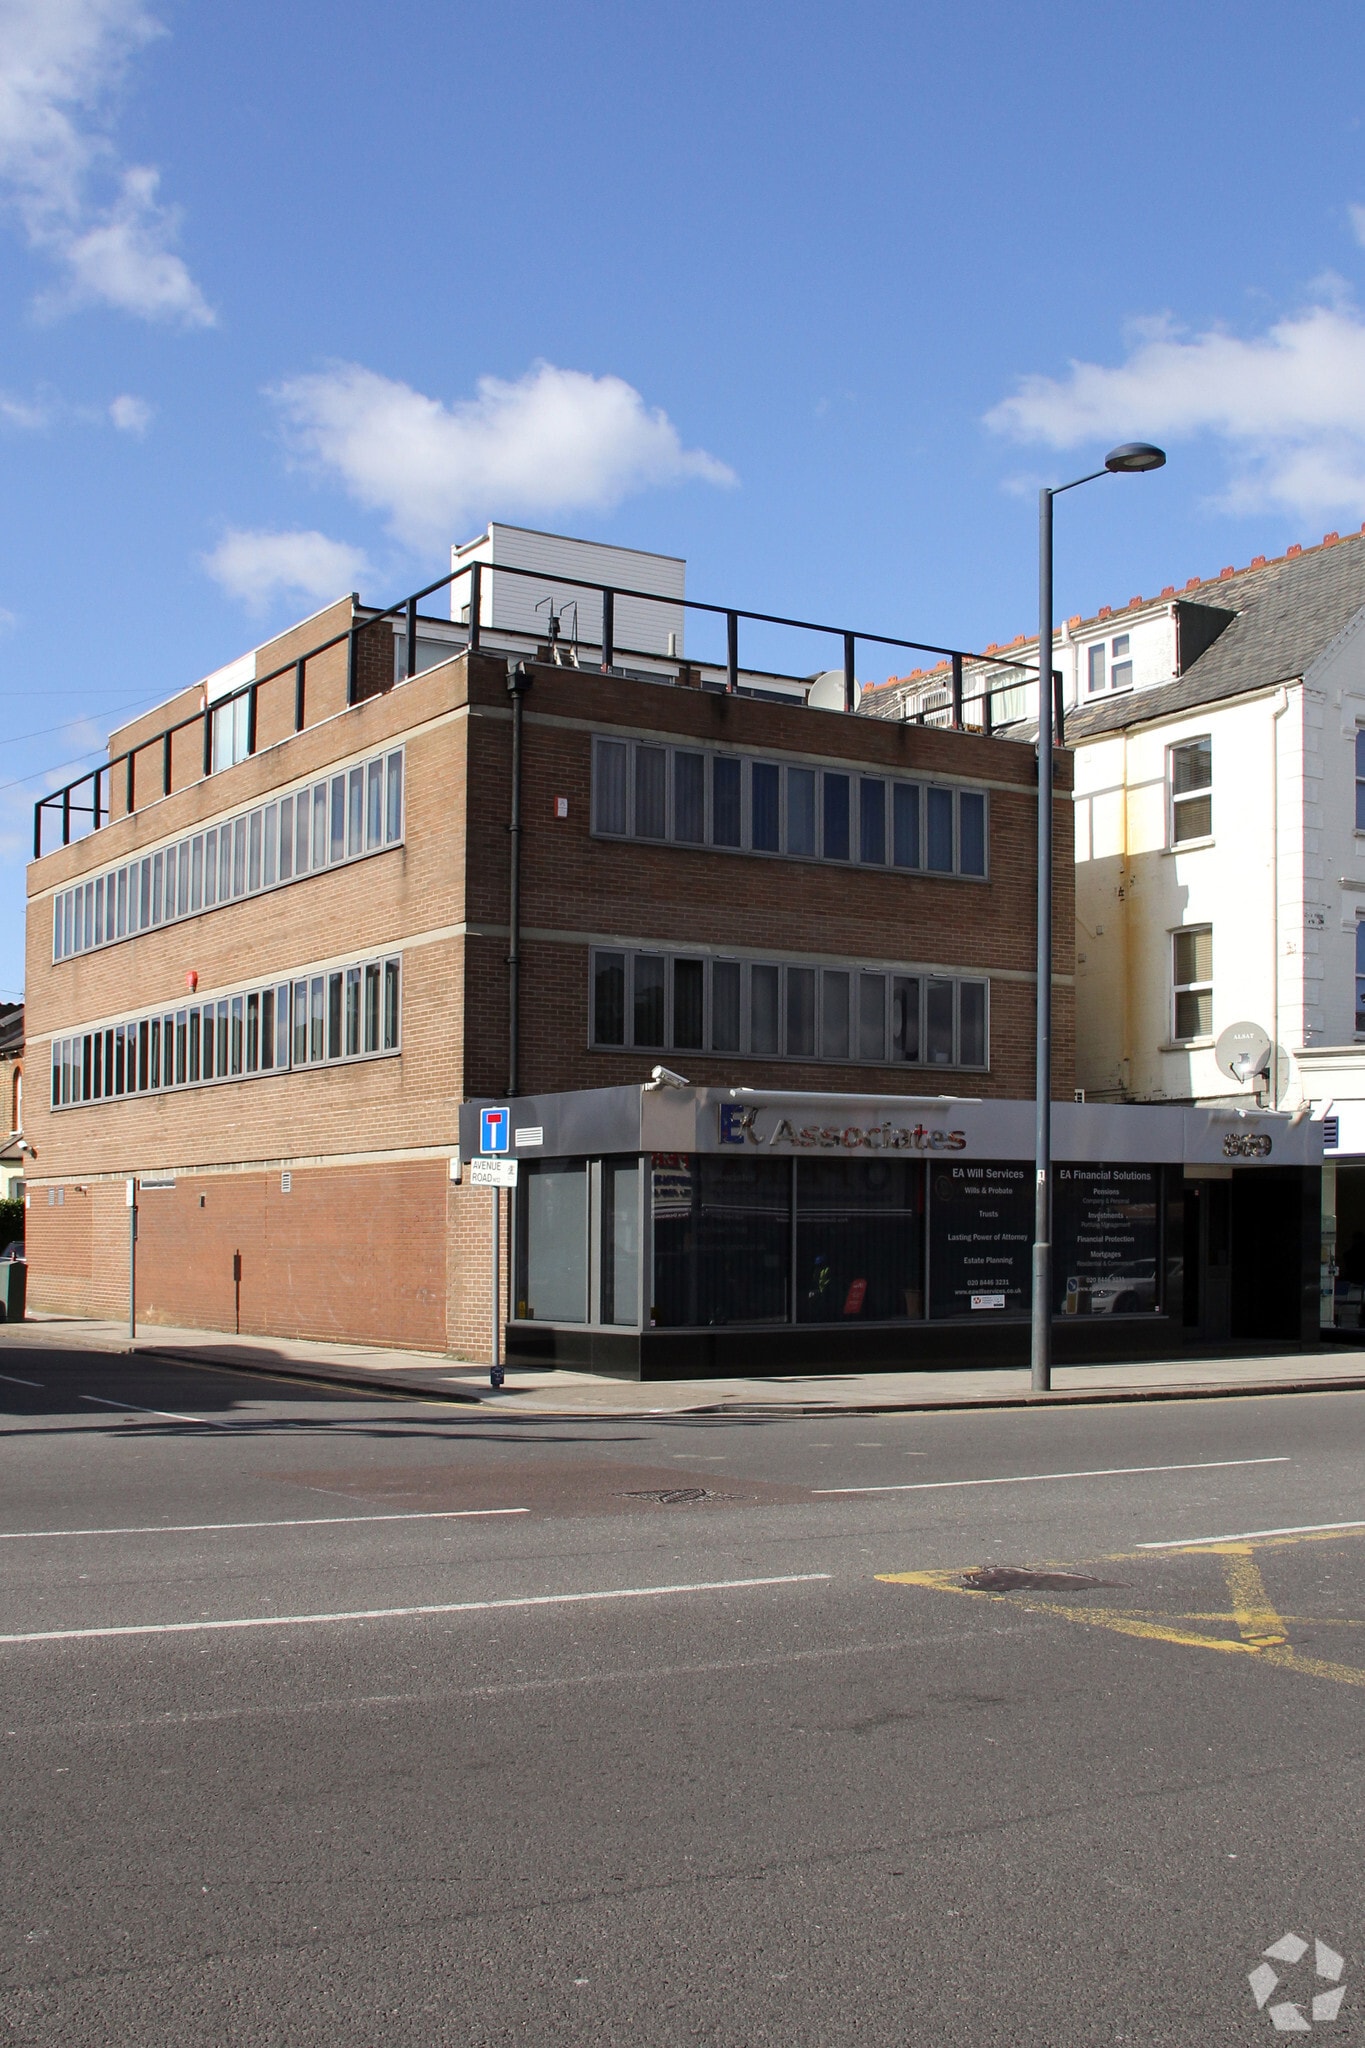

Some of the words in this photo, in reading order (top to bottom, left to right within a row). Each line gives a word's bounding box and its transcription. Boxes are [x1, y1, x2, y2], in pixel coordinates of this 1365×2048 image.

[769, 1119, 967, 1151] Associates
[473, 1160, 502, 1171] AVENUE
[472, 1172, 493, 1182] ROAD
[952, 1168, 965, 1178] EA
[967, 1168, 984, 1178] Will
[986, 1168, 1024, 1179] Services
[1060, 1170, 1071, 1179] EA
[1073, 1170, 1111, 1180] Financial
[1113, 1170, 1151, 1180] Solutions
[965, 1186, 980, 1194] Wills
[948, 1233, 972, 1242] Lasting
[1001, 1233, 1028, 1242] Attorney
[1090, 1250, 1121, 1259] Mortgages
[963, 1256, 984, 1264] Estate
[986, 1256, 1013, 1265] Planning
